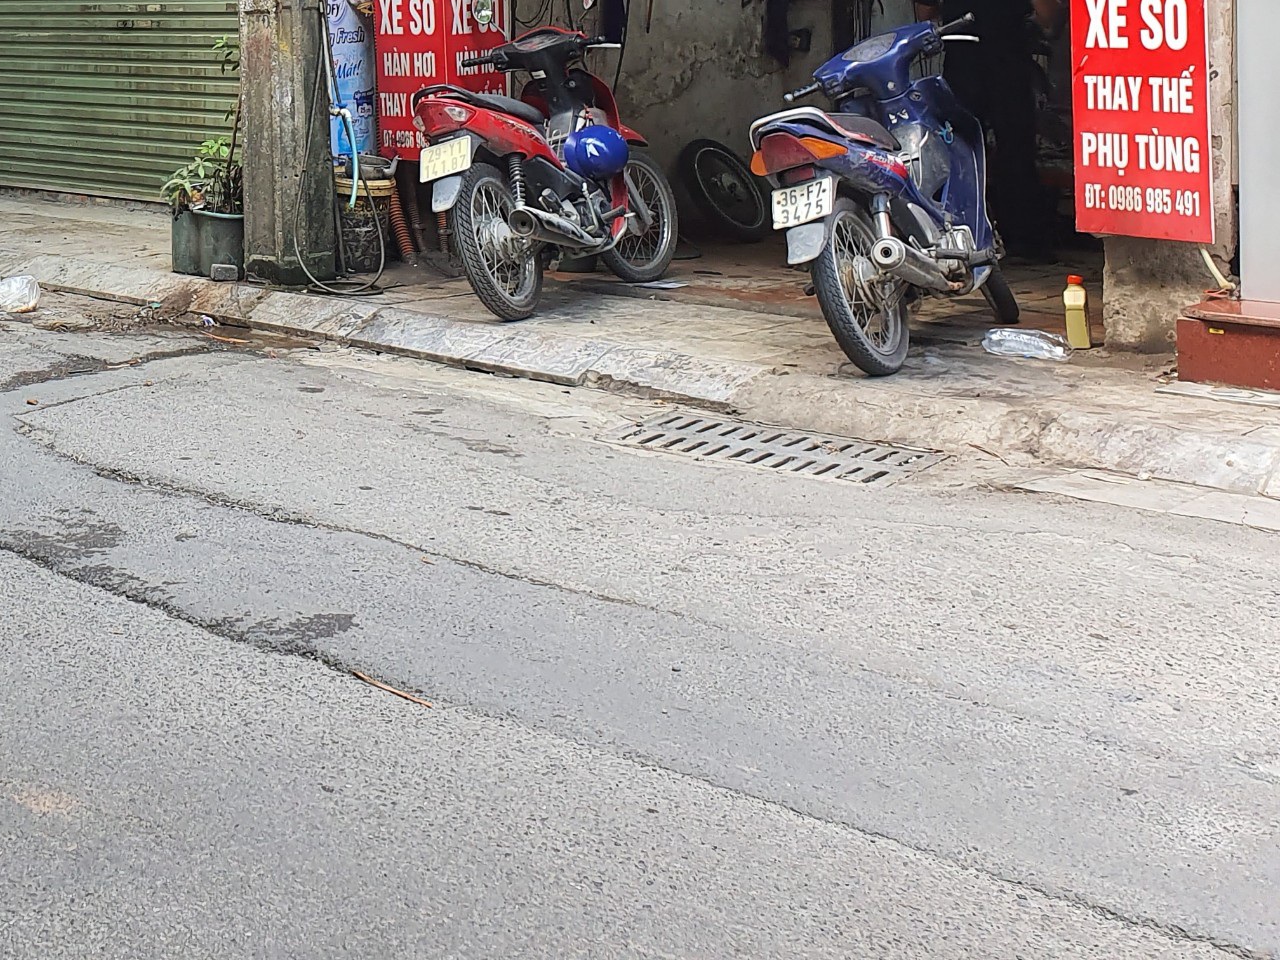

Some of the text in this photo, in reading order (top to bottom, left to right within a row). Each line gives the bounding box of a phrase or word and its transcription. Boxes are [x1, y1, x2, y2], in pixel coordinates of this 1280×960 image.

[335, 26, 365, 45] Fresh
[383, 47, 436, 78] HÀN HƠI
[1083, 65, 1196, 114] THAY THẾ
[380, 92, 407, 117] THAY
[1081, 127, 1200, 176] PHỤ TÙNG
[780, 181, 823, 207] 36-F7
[1084, 183, 1200, 217] ĐT: 0986 985 491
[781, 199, 823, 224] 3475
